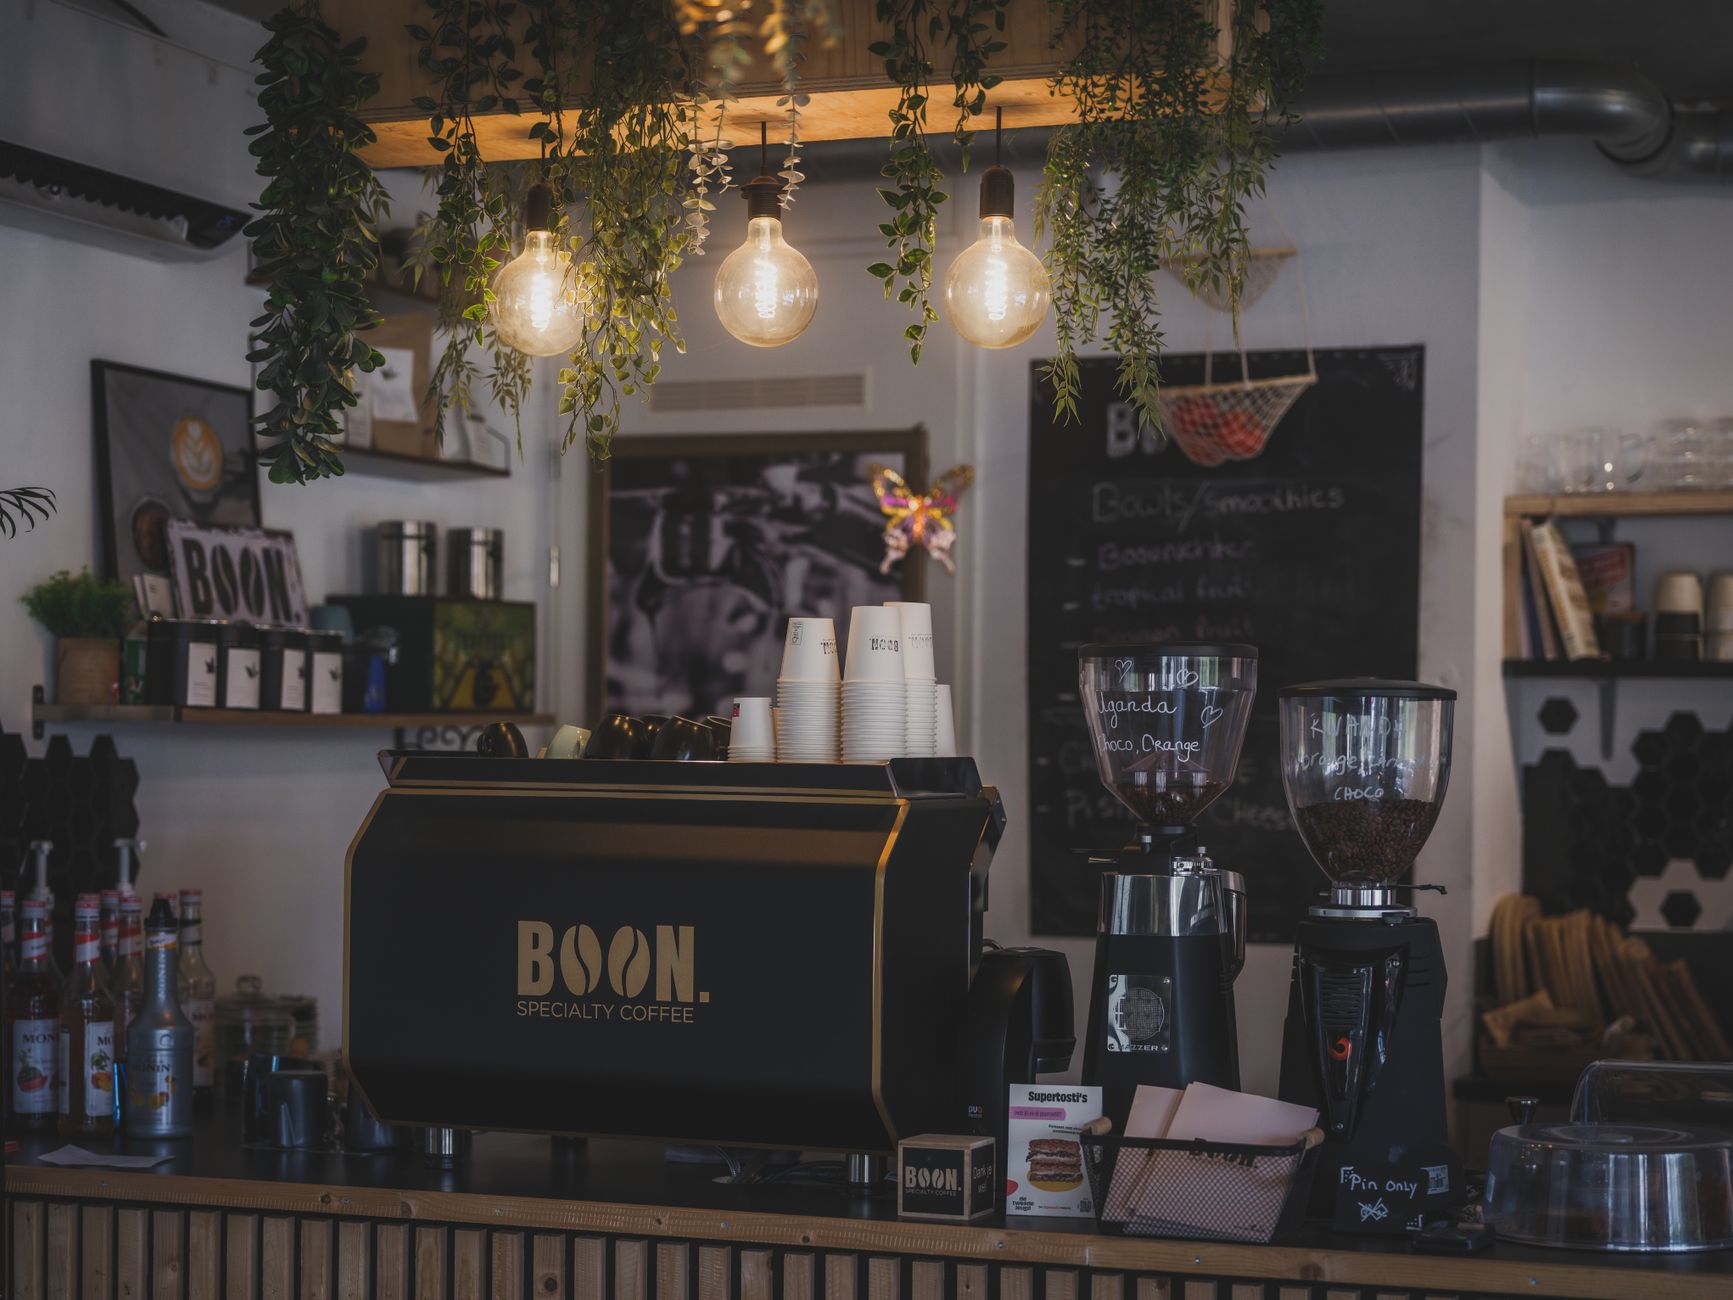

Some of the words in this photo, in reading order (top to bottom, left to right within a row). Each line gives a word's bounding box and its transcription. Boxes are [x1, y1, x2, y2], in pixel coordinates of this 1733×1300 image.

[182, 539, 300, 622] BOON.
[517, 919, 711, 1004] BOON.
[516, 1000, 615, 1021] SPECIALTY
[620, 1003, 695, 1024] COFFEE
[1028, 1091, 1087, 1104] Supertosti's
[905, 1166, 962, 1191] BOON.
